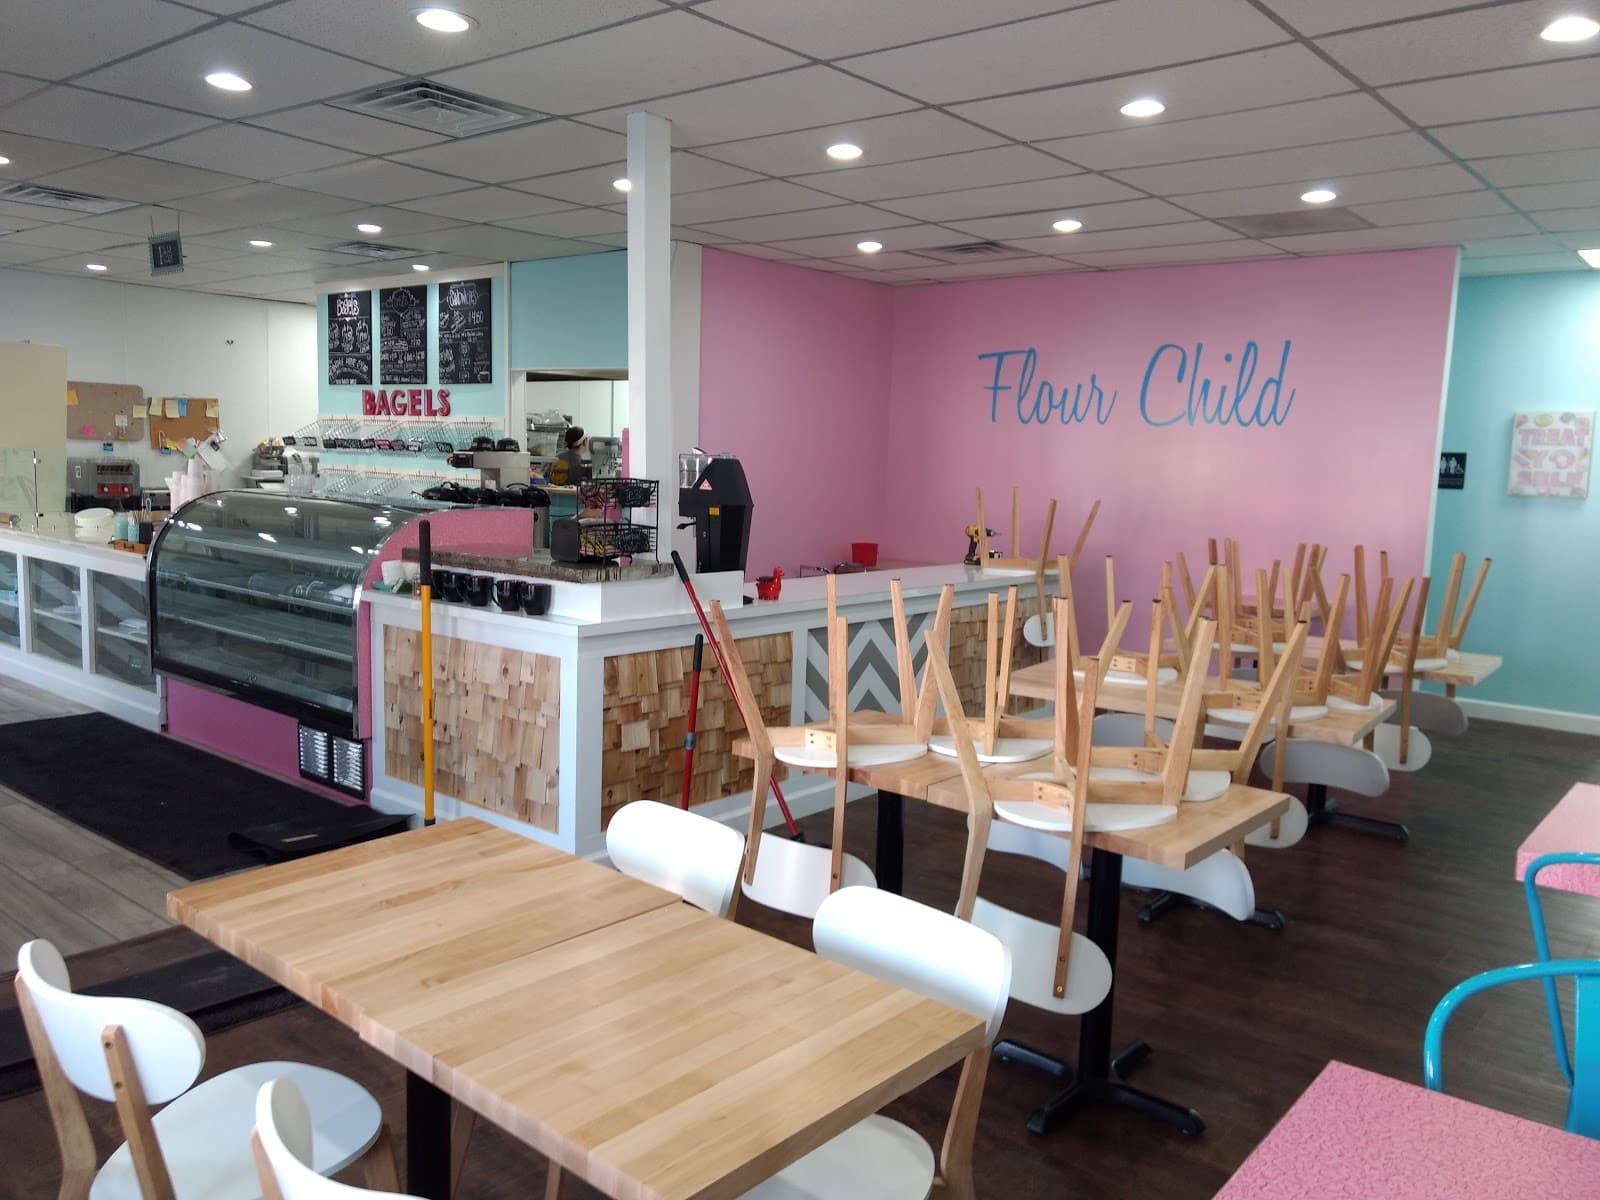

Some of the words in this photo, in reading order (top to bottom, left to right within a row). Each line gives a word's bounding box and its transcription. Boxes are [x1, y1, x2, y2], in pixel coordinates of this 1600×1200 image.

[978, 347, 1117, 425] Flour
[1139, 340, 1296, 428] Child
[361, 388, 451, 417] BAGELS
[1518, 428, 1590, 446] TREAT
